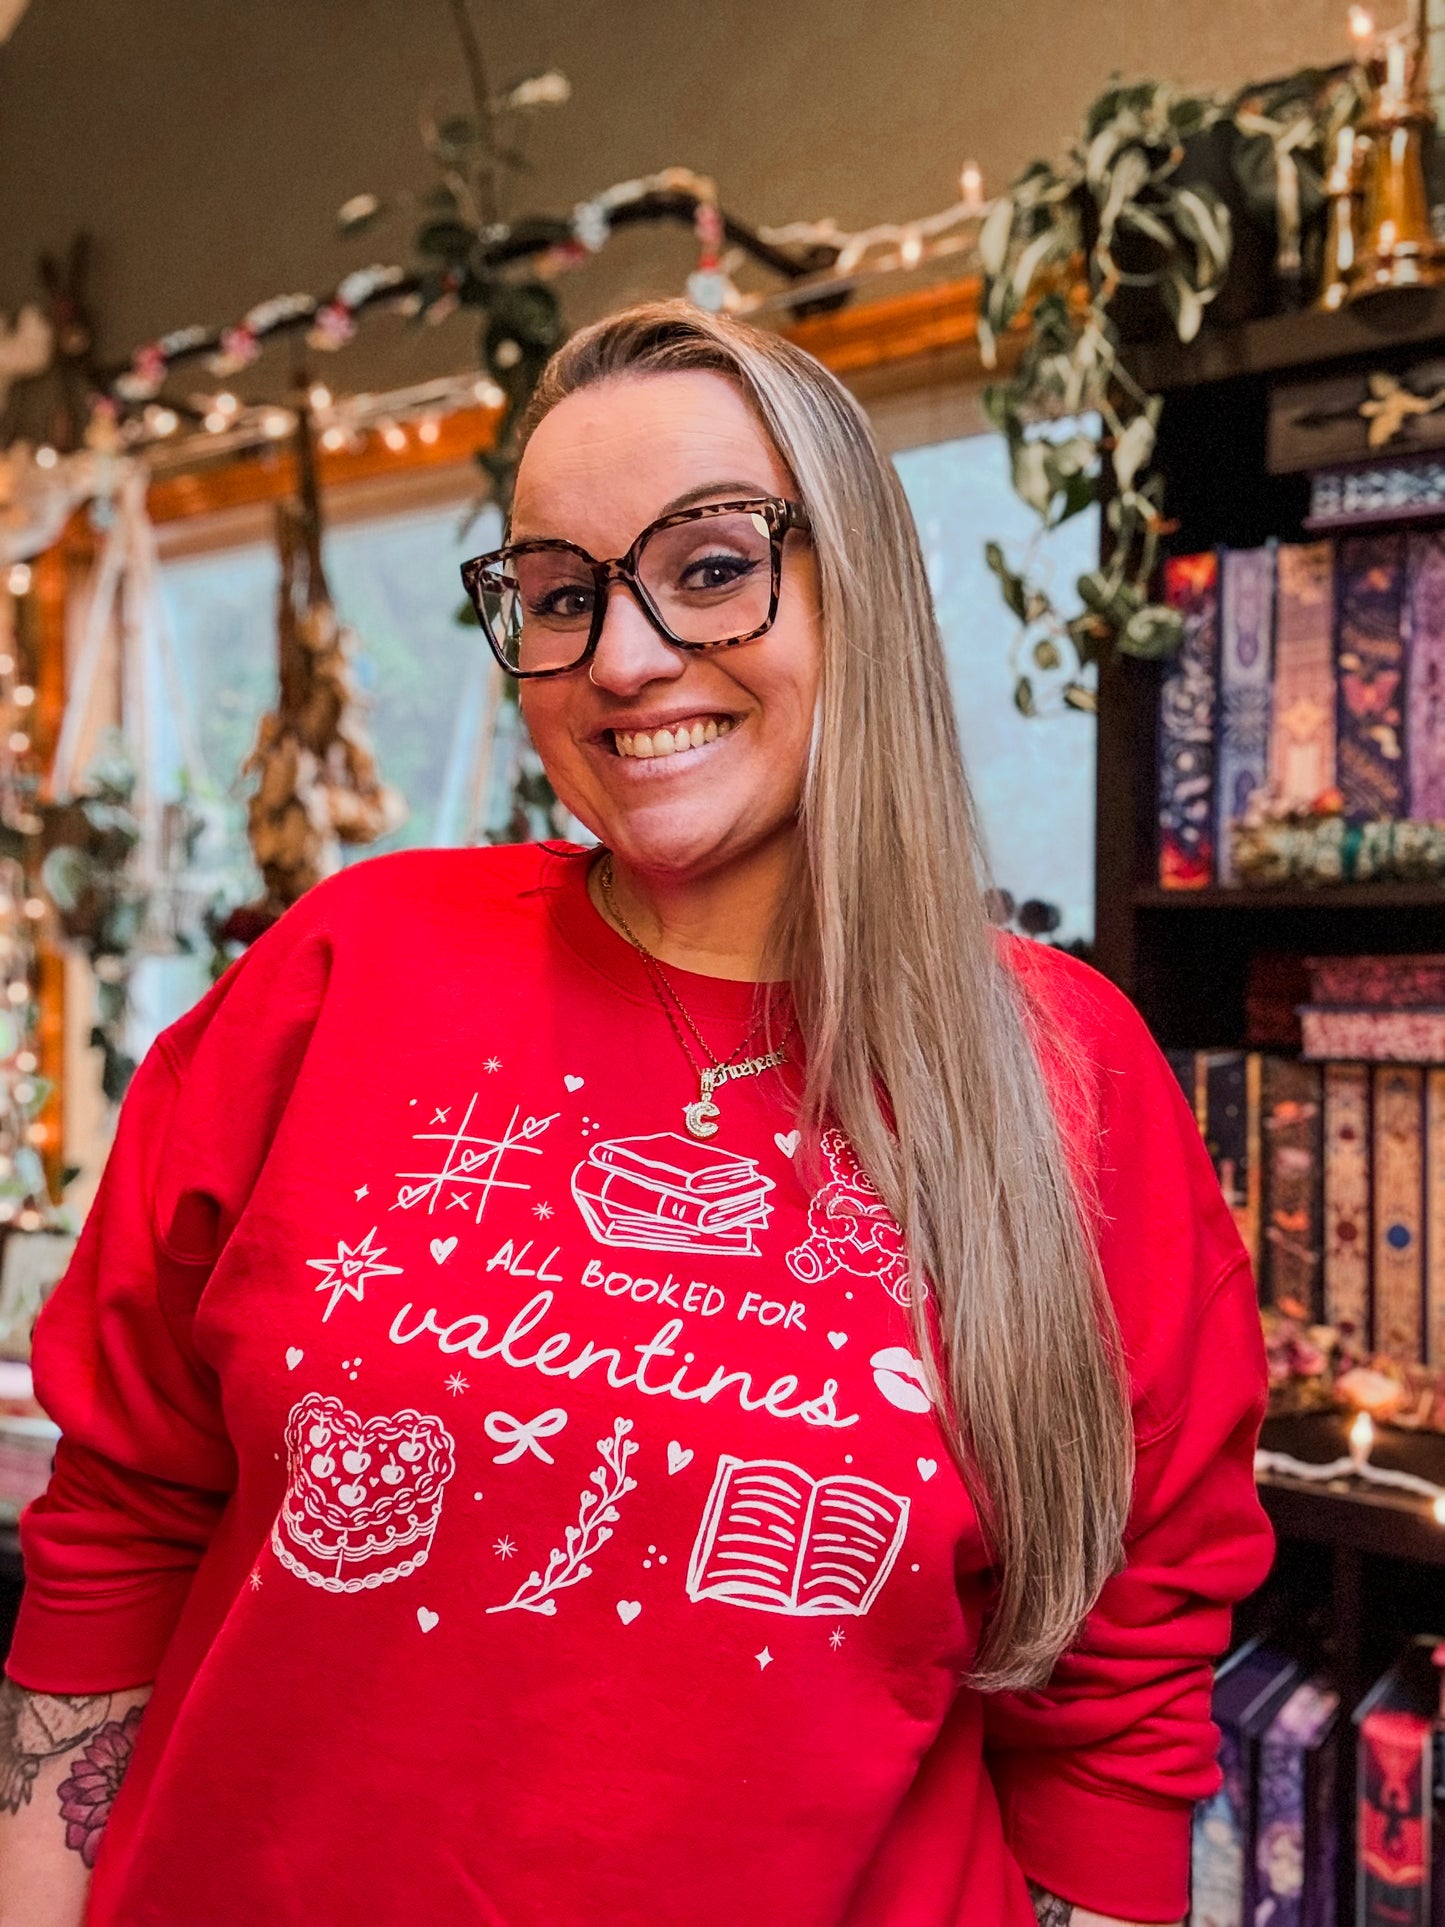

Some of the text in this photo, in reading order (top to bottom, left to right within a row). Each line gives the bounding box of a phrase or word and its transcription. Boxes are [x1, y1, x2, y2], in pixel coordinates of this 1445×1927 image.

[486, 1239, 807, 1332] ALL BOOKED FOR
[388, 1289, 860, 1429] valentines
